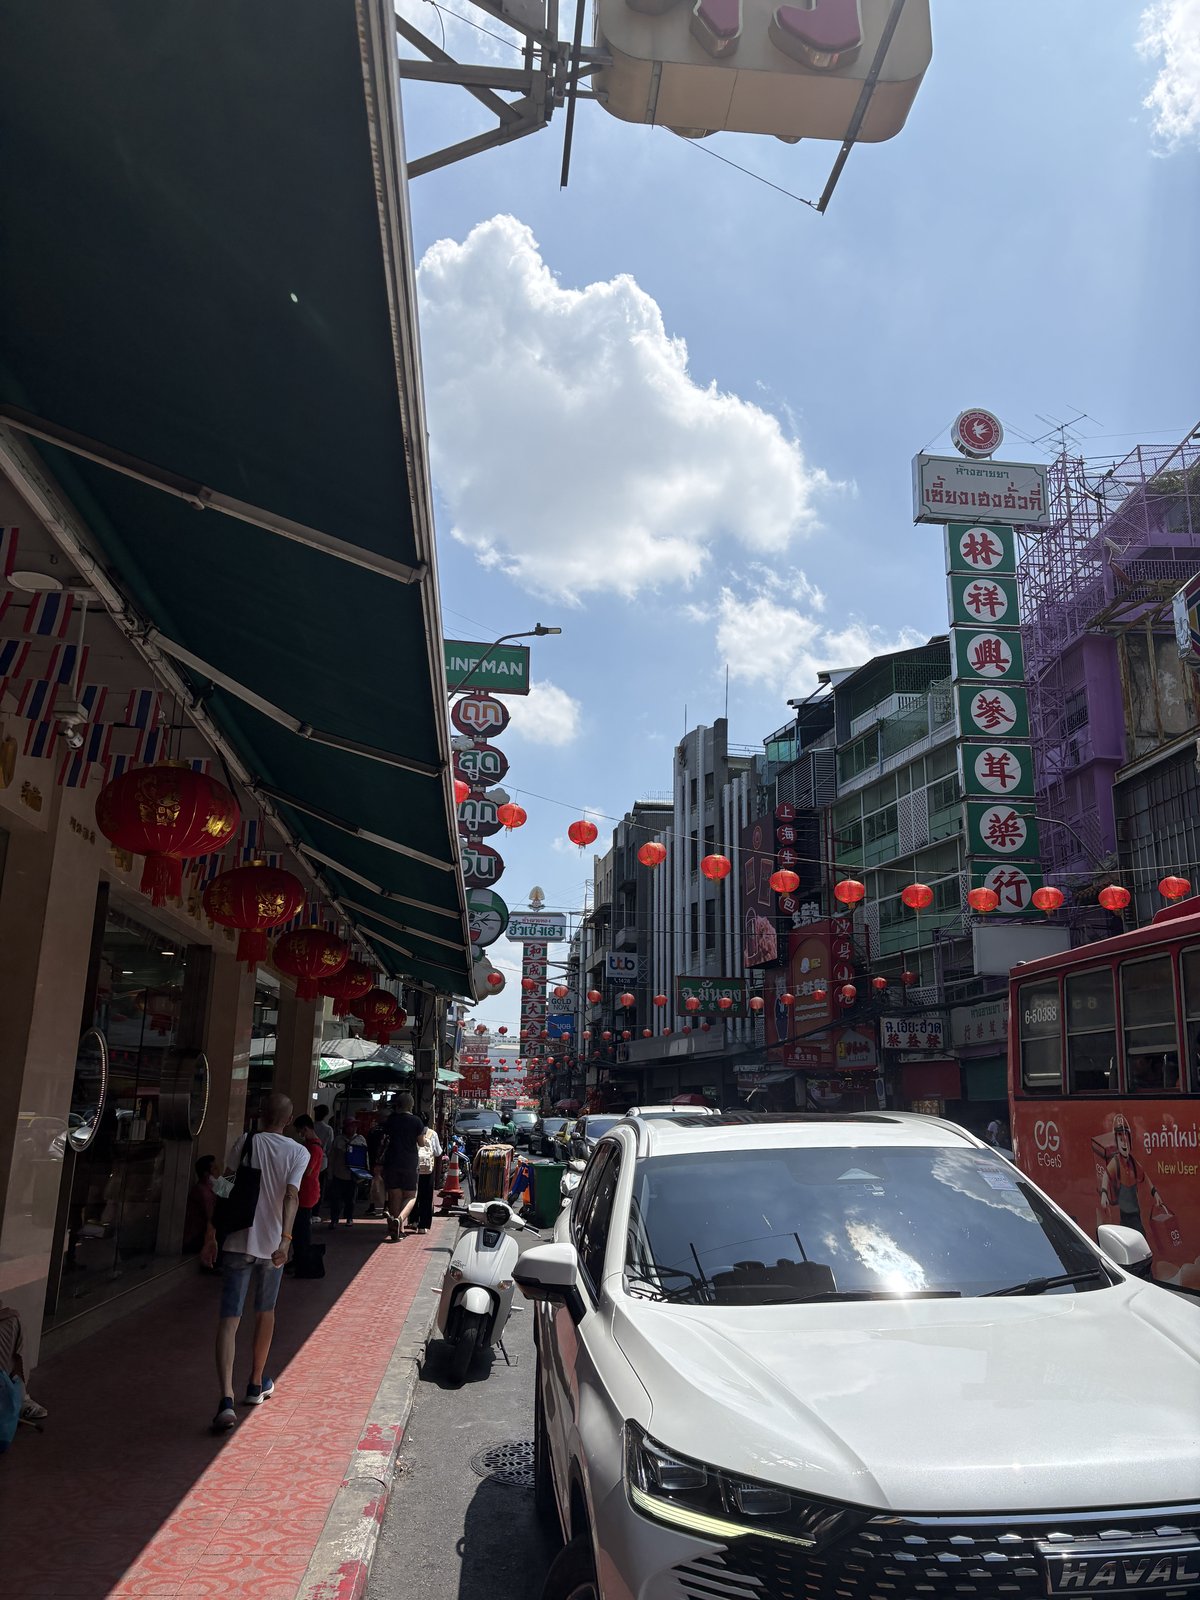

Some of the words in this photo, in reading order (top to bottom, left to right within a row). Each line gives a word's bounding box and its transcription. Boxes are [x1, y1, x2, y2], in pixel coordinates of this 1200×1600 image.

[955, 464, 1010, 479] ห้างขายยา
[780, 805, 795, 912] 上海生包
[609, 956, 635, 971] ttb
[1157, 1161, 1176, 1175] New
[1177, 1161, 1198, 1176] User
[1058, 1555, 1200, 1588] HAVAL
